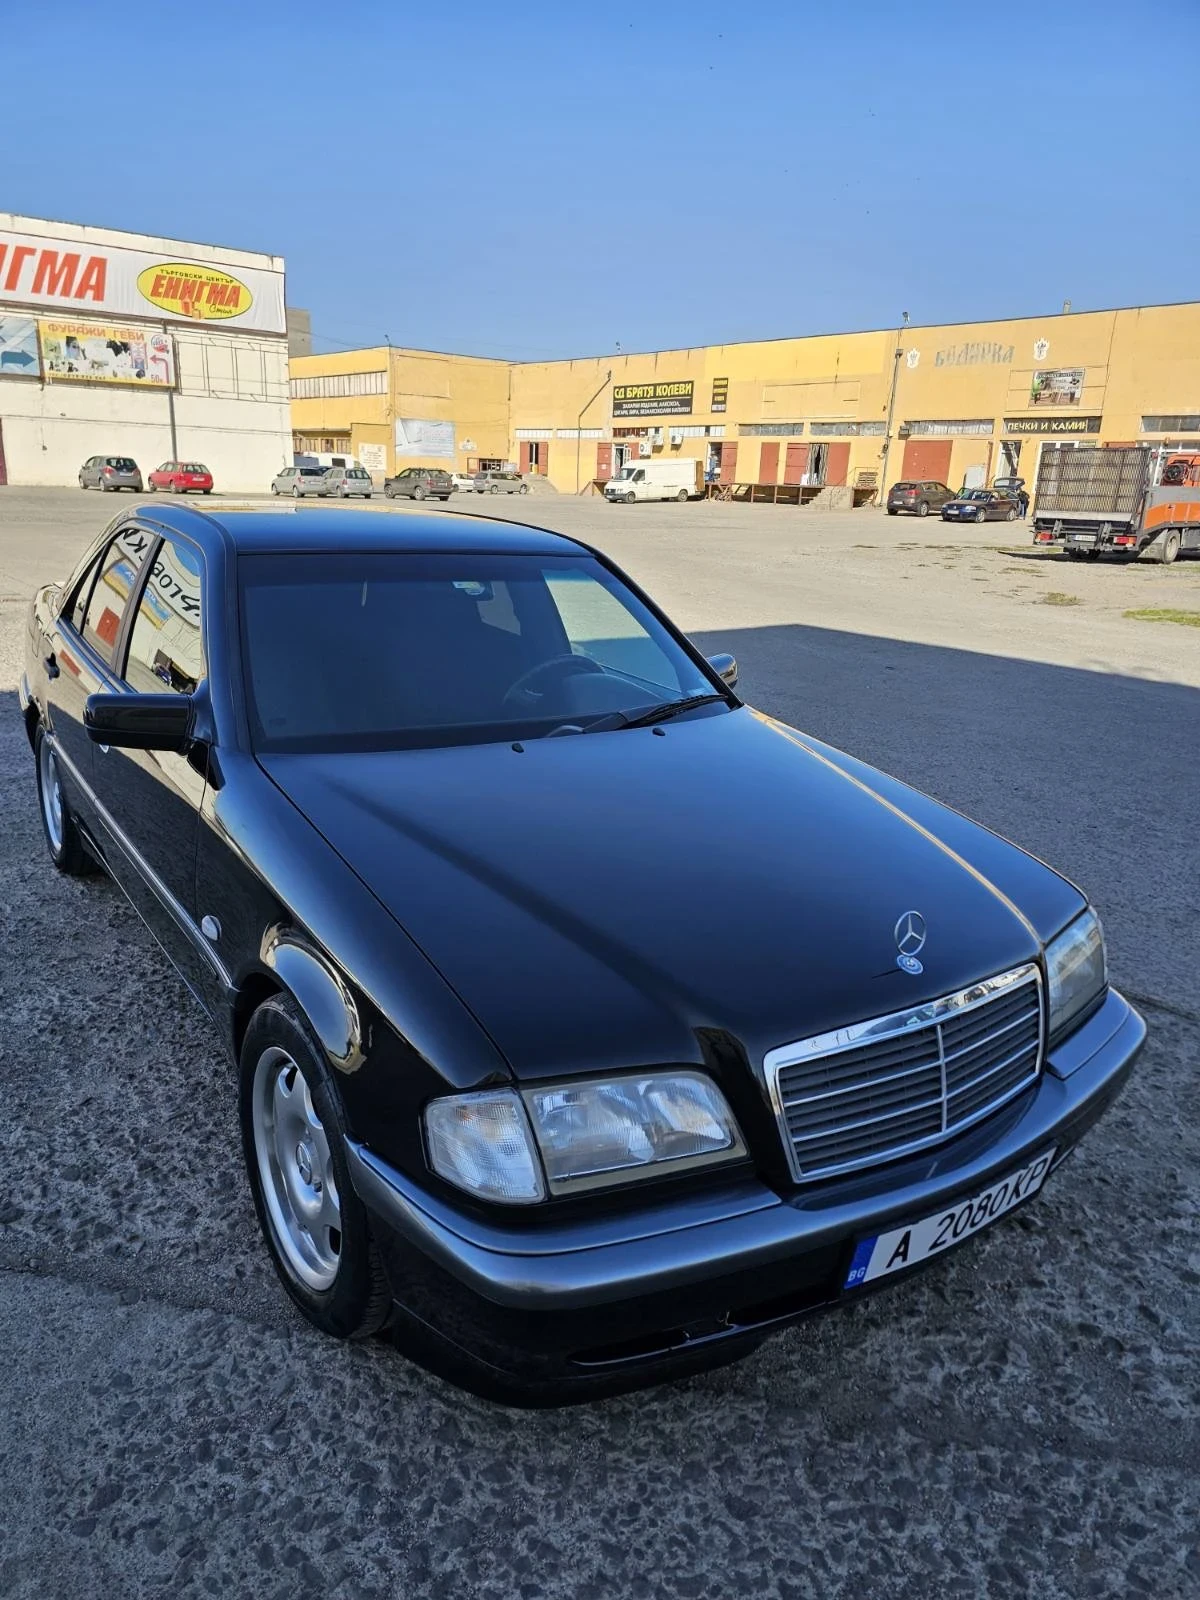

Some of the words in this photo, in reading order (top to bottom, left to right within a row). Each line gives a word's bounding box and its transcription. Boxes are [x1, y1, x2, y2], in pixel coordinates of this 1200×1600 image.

[0, 243, 107, 301] ГМА
[160, 269, 203, 280] ТЪРГОВСКИ
[206, 275, 234, 284] ЦЕНТЪР
[150, 274, 241, 308] ЕНИГМА
[48, 323, 106, 337] ФУРАЖИ
[113, 331, 145, 344] ГЕБИ
[626, 386, 654, 398] БРАТЯ
[656, 383, 692, 396] КОЛЕВИ
[1007, 421, 1038, 431] ПЕЧКИ
[1040, 422, 1048, 430] И
[885, 1230, 912, 1269] A
[847, 1266, 866, 1282] BG
